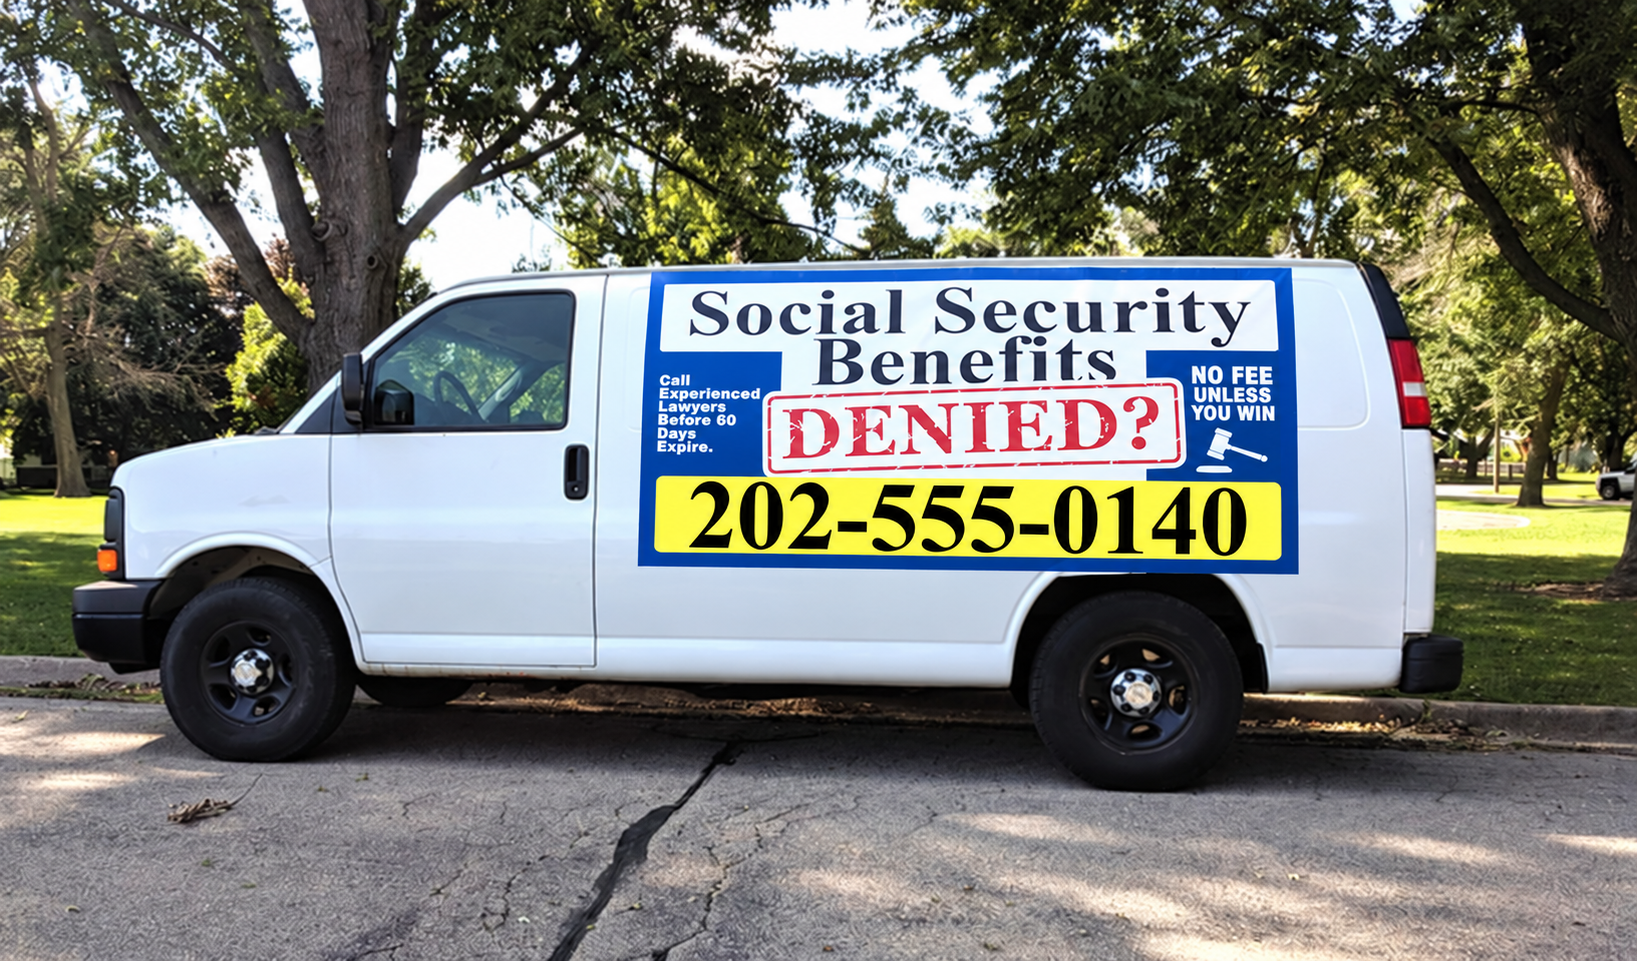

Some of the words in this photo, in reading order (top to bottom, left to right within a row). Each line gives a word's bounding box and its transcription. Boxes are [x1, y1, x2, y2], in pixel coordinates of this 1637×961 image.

[689, 289, 906, 336] Social
[934, 286, 1251, 347] Security
[812, 335, 1117, 385] Benefits
[660, 374, 690, 386] Call
[1191, 365, 1224, 385] NO
[1231, 365, 1273, 385] FEE
[659, 387, 761, 402] Experienced
[1194, 387, 1272, 403] UNLESS
[659, 400, 726, 415] Lawyers
[1190, 404, 1231, 421] YOU
[1236, 405, 1275, 421] WIN
[658, 413, 711, 426] Before
[716, 414, 737, 426] 60
[783, 396, 1159, 459] DENIED?
[657, 427, 696, 442] Days
[657, 440, 713, 455] Expire.
[689, 481, 1247, 556] 202-555-0140
